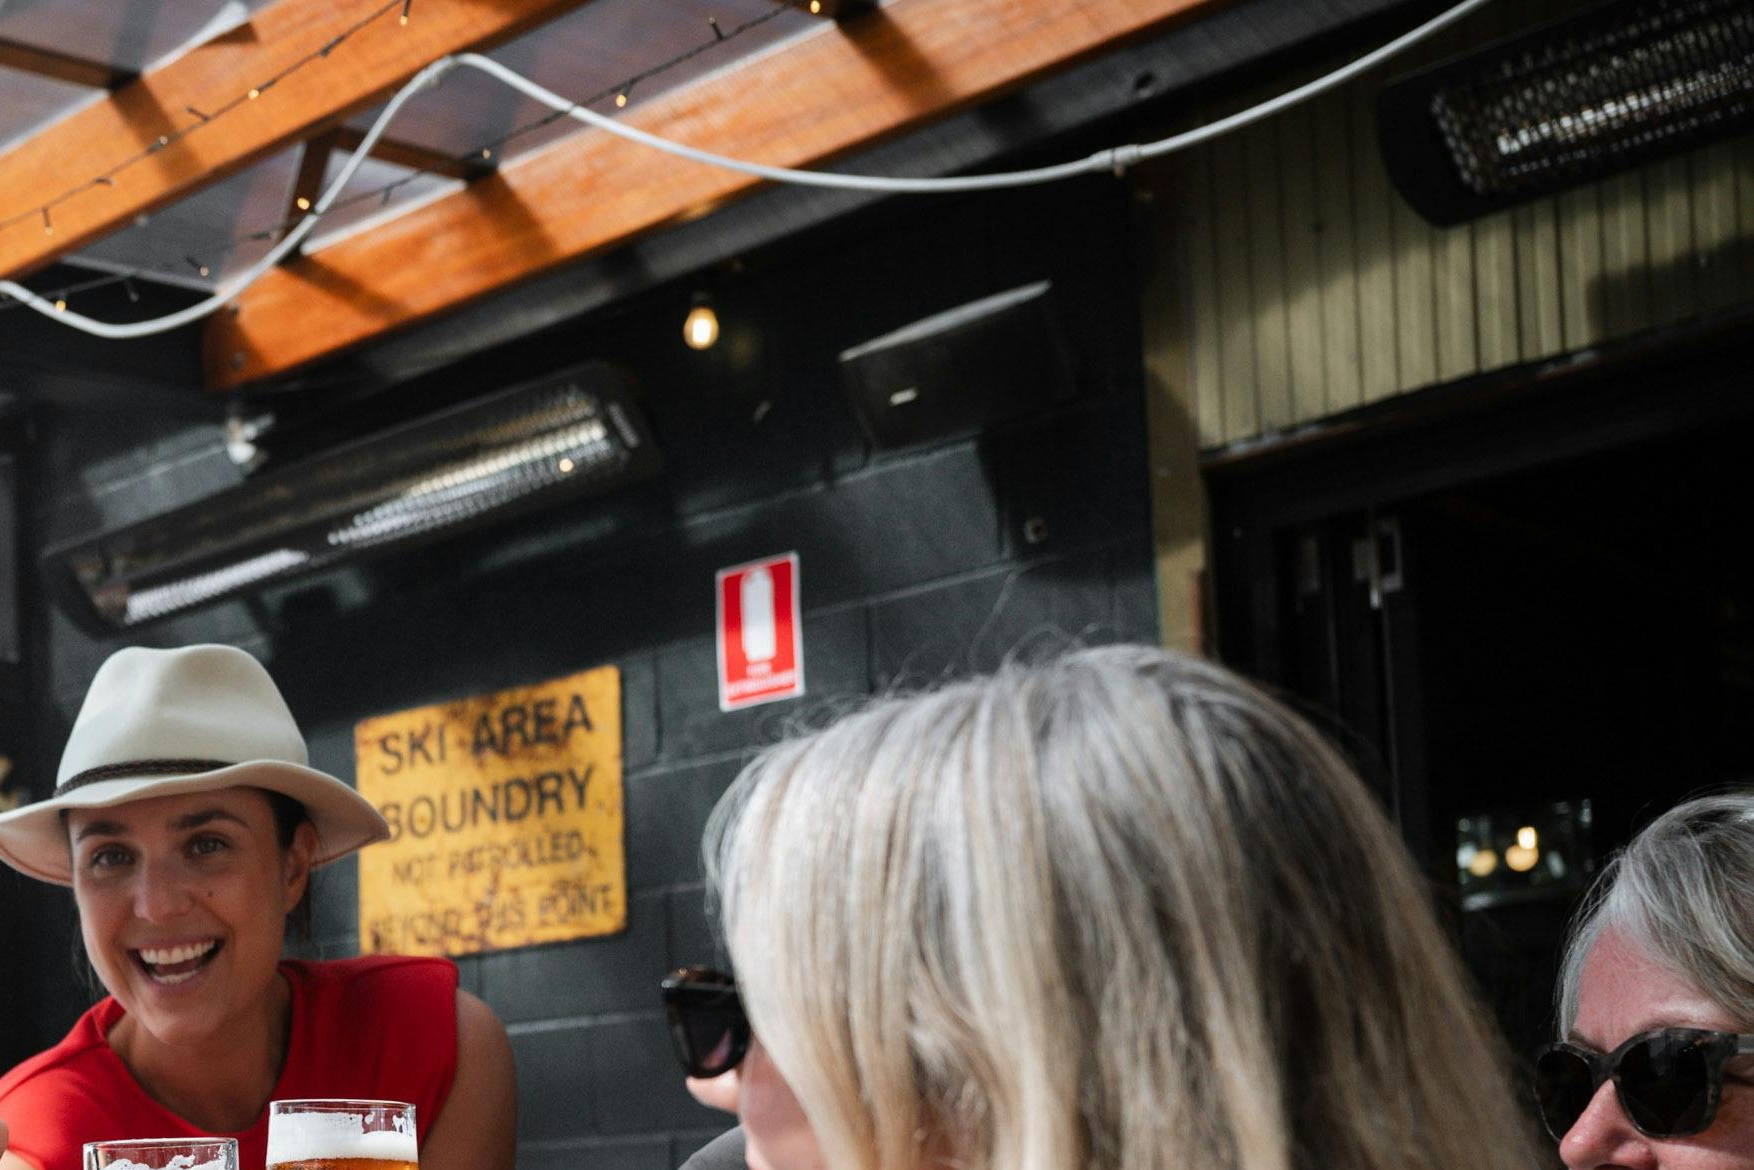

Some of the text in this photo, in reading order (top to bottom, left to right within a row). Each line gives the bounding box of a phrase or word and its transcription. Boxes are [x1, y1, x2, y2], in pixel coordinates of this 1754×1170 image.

[379, 694, 593, 776] SKI AREA
[378, 764, 594, 843] BOUNDRY
